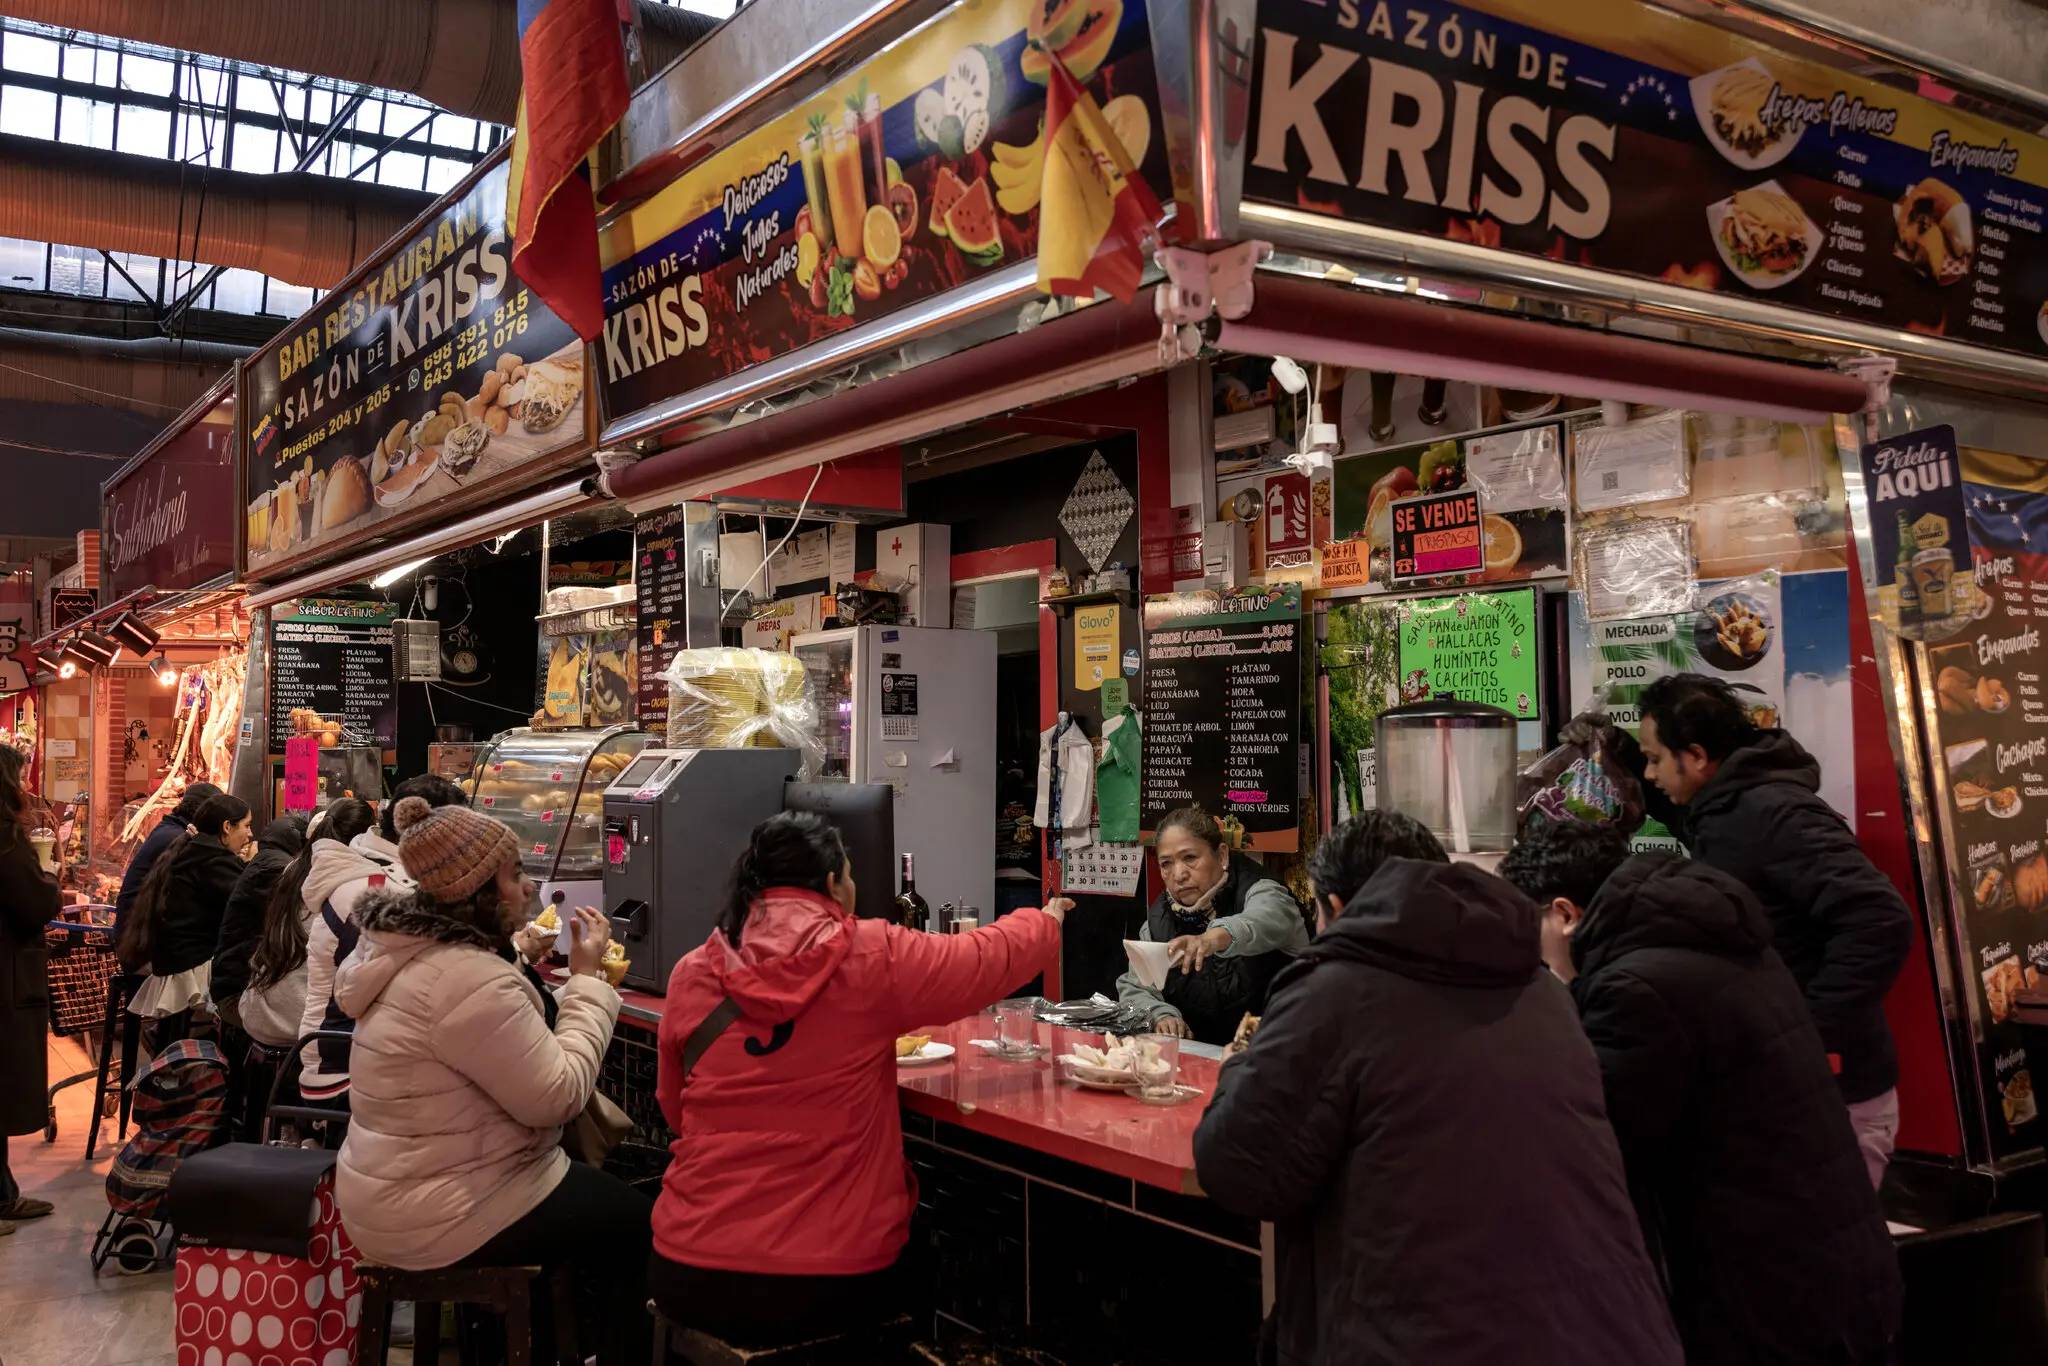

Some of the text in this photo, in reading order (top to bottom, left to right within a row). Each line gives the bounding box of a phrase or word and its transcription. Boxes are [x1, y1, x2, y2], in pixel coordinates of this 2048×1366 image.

[1337, 0, 1569, 90] SAZÓN DE
[1760, 82, 1824, 128] Arepas
[1252, 27, 1617, 240] KRISS
[742, 211, 780, 263] Jugos
[612, 253, 678, 303] SAZÓN DE
[736, 244, 800, 312] Naturales
[368, 341, 384, 364] DE
[389, 227, 508, 367] KRISS
[423, 290, 529, 372] 698 391 815
[602, 272, 709, 383] KRISS
[279, 326, 320, 382] BAR
[423, 313, 529, 391] 643 422 076
[282, 384, 390, 464] Puestos 204 y 205
[1876, 451, 1952, 502] AQUÍ
[1395, 497, 1477, 533] SE VENDE
[1975, 554, 2015, 587] Arepas
[299, 605, 336, 615] SABOR
[1220, 595, 1269, 614] LATINO
[756, 620, 781, 632] AREPAS
[1079, 615, 1110, 629] Glovo
[1429, 613, 1500, 633] PAN de JAMON
[1604, 622, 1669, 640] MECHADA
[1436, 631, 1501, 649] HALLACAS
[1976, 623, 2040, 666] Empanadas
[1151, 669, 1176, 677] FRESA
[1231, 663, 1270, 673] PLÁTANO
[1607, 665, 1646, 679] POLLO
[1151, 680, 1179, 688] MANGO
[1231, 674, 1280, 684] TAMARINDO
[1231, 687, 1255, 696] MORA
[1150, 712, 1176, 721] MELÓN
[1231, 708, 1287, 719] PAPELÓN CON
[1150, 723, 1181, 732] TOMATE
[1182, 723, 1193, 731] DE
[1230, 720, 1255, 731] LIMÓN
[1230, 732, 1289, 742] NARANJA CON
[1149, 745, 1182, 754] PAPAYA
[1230, 745, 1280, 754] ZANAHORIA
[1149, 756, 1192, 765] AGUACATE
[1230, 756, 1235, 765] 3
[1237, 756, 1248, 765] EN
[1149, 767, 1186, 776] NARANJA
[1229, 768, 1264, 777] COCADA
[1148, 779, 1179, 788] CURUBA
[1229, 780, 1259, 789] CHICHA
[1148, 789, 1193, 799] MELOCOTÓN
[1148, 800, 1166, 810] PIÑA
[1229, 803, 1290, 813] JUGOS VERDES
